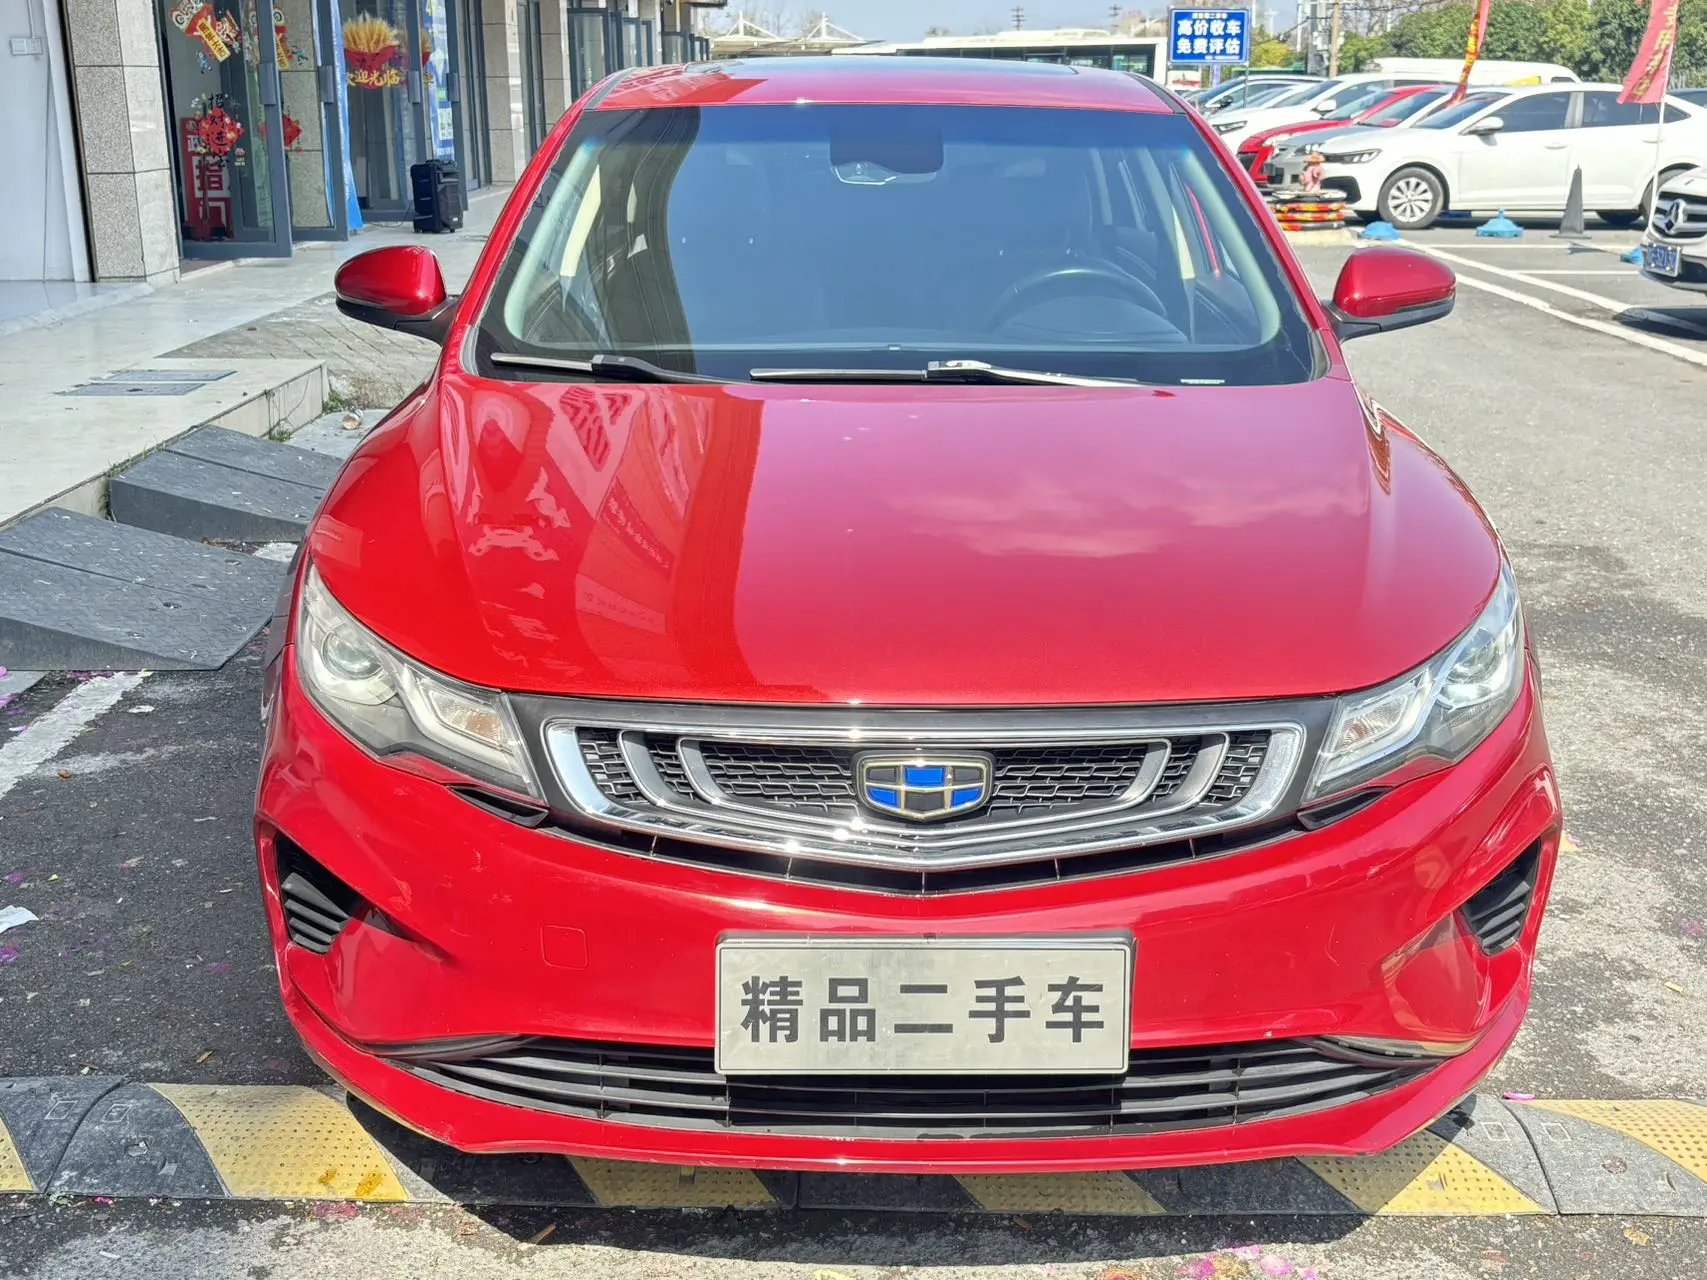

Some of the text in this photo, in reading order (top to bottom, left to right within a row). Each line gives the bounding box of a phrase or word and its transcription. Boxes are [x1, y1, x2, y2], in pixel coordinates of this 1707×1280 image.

[1177, 19, 1241, 36] 高价收车
[1176, 37, 1241, 54] 免费评估
[740, 975, 1105, 1043] 精品二手车
